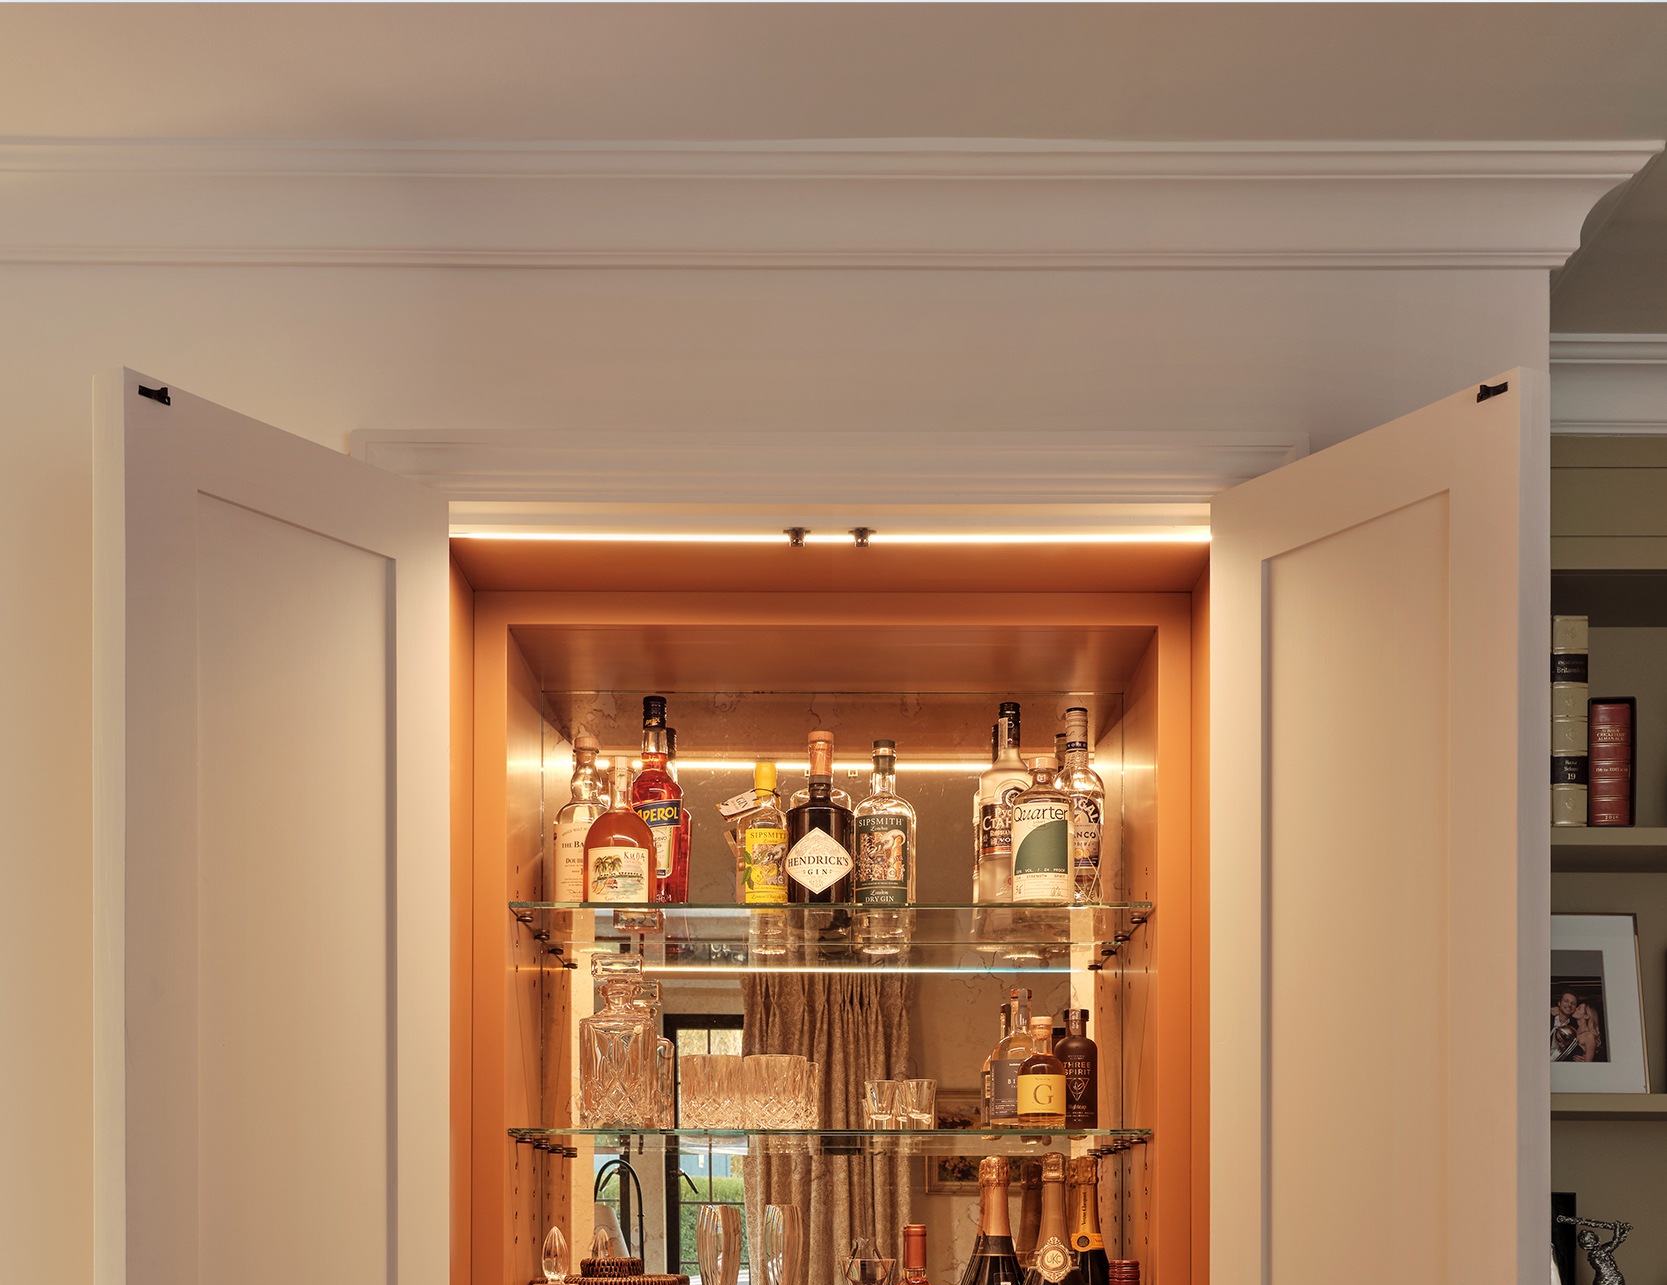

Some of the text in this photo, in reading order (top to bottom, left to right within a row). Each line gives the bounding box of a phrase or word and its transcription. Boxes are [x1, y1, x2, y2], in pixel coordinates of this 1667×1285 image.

[636, 806, 679, 821] APEROL
[1014, 806, 1068, 822] Quarter
[859, 818, 902, 826] SIPSMITH
[788, 855, 849, 868] HENDRICK'S
[1033, 1083, 1054, 1105] G
